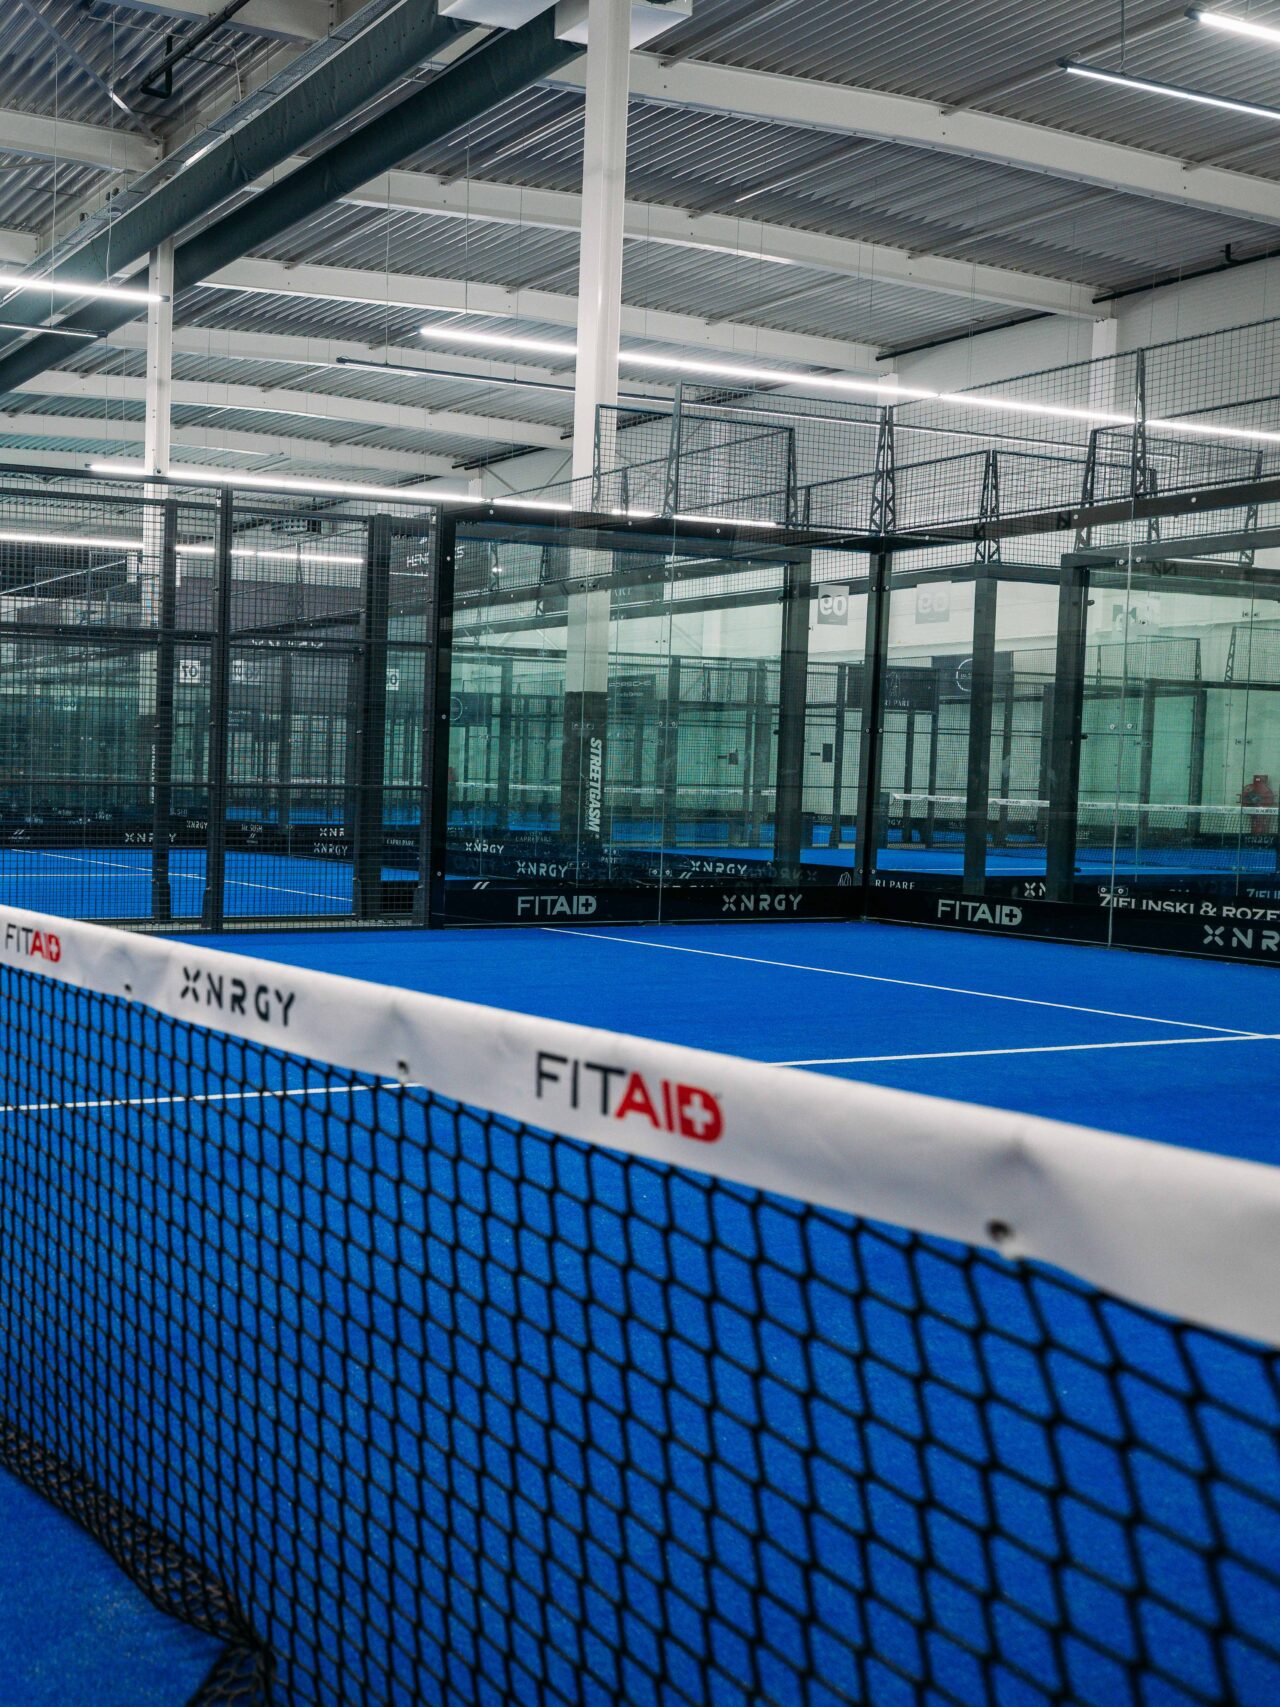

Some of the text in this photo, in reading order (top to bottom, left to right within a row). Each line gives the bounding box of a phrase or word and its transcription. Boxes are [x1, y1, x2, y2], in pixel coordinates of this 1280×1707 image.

[465, 842, 505, 855] XNRGY
[516, 862, 569, 879] XNRGY
[690, 860, 748, 876] XNRGY
[517, 896, 597, 916] FITAID
[721, 894, 803, 912] XNRGY
[937, 899, 1023, 926] FITAID
[4, 923, 62, 963] FITAID
[180, 966, 296, 1026] XNRGY
[535, 1050, 725, 1144] FITAID
